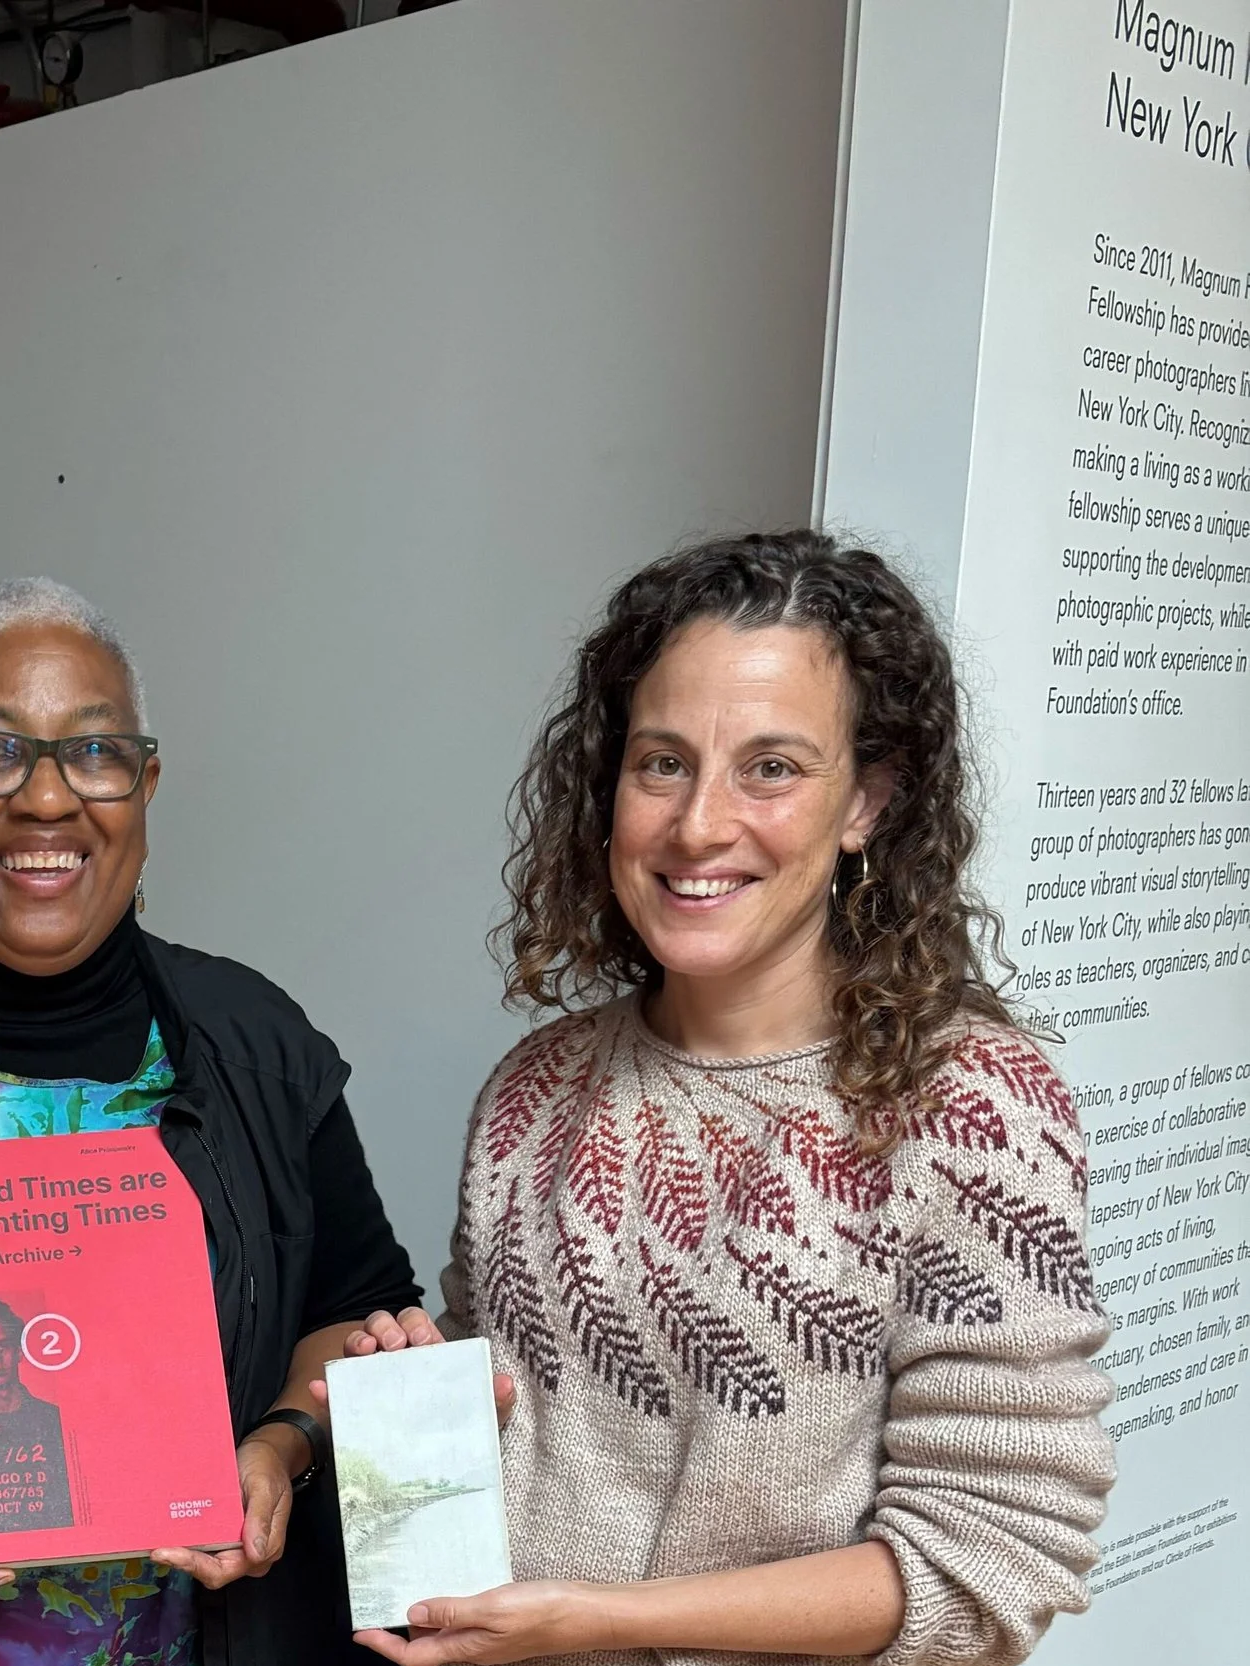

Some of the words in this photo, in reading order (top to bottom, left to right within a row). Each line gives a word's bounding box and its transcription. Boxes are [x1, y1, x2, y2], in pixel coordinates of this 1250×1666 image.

[1115, 0, 1234, 80] Magnum
[1106, 72, 1172, 144] New
[1183, 96, 1237, 166] York
[1094, 233, 1135, 271] Since
[1139, 246, 1175, 287] 2011,
[1180, 256, 1240, 298] Magnum
[1088, 286, 1166, 337] Fellowship
[1169, 304, 1195, 337] has
[1084, 347, 1132, 375] career
[1134, 350, 1236, 396] photographers
[1078, 388, 1113, 422] New
[1119, 395, 1149, 428] York
[1153, 403, 1184, 440] City.
[1073, 443, 1126, 481] making
[1130, 457, 1139, 476] a
[1143, 450, 1180, 488] living
[1184, 466, 1200, 485] as
[1204, 468, 1212, 487] a
[1069, 490, 1141, 532] fellowship
[1145, 509, 1191, 531] serves
[1194, 515, 1203, 533] a
[1207, 510, 1250, 543] unique
[1063, 546, 1141, 580] supporting
[1146, 549, 1168, 576] the
[1056, 590, 1154, 628] photographic
[1156, 599, 1215, 631] projects,
[1220, 602, 1250, 629] while
[1053, 639, 1082, 666] with
[1086, 641, 1120, 674] paid
[1124, 643, 1158, 669] work
[1161, 646, 1232, 677] experience
[1235, 648, 1247, 672] in
[1047, 687, 1138, 715] Foundation's
[1142, 689, 1183, 715] office.
[1037, 782, 1095, 808] Thirteen
[1098, 788, 1136, 813] years
[1140, 779, 1167, 805] and
[1170, 779, 1187, 804] 32
[1189, 778, 1234, 803] fellows
[1031, 836, 1074, 862] group
[1079, 826, 1095, 852] of
[1096, 823, 1196, 858] photographers
[1199, 821, 1222, 845] has
[1026, 874, 1086, 908] produce
[1091, 870, 1137, 896] vibrant
[1142, 865, 1179, 892] visual
[1181, 862, 1250, 894] storytelling
[1022, 921, 1038, 947] of
[1041, 919, 1075, 944] New
[1079, 914, 1108, 940] York
[1112, 912, 1142, 942] City,
[1148, 908, 1181, 934] while
[1184, 906, 1211, 930] also
[1016, 965, 1051, 992] roles
[1055, 969, 1072, 987] as
[1076, 956, 1137, 984] teachers,
[1143, 948, 1210, 980] organizers,
[1214, 942, 1240, 967] and
[1028, 1009, 1059, 1032] their
[1063, 995, 1150, 1030] communities.
[1119, 1085, 1128, 1101] a
[1131, 1078, 1169, 1104] group
[1173, 1068, 1188, 1091] of
[1190, 1064, 1232, 1088] fellows
[1095, 1120, 1148, 1145] exercise
[1152, 1110, 1167, 1134] of
[1169, 1101, 1246, 1132] collaborative
[1089, 1157, 1132, 1187] eaving
[1135, 1153, 1164, 1176] their
[1165, 1136, 1225, 1169] individual
[19, 1176, 113, 1204] Times
[119, 1169, 167, 1192] are
[1091, 1196, 1144, 1228] tapestry
[1146, 1187, 1161, 1211] of
[1163, 1184, 1192, 1207] New
[1196, 1174, 1222, 1199] York
[1225, 1170, 1250, 1194] City
[73, 1203, 167, 1228] Times
[1136, 1229, 1163, 1251] acts
[1166, 1219, 1181, 1243] of
[1182, 1215, 1216, 1240] living,
[1094, 1272, 1141, 1304] agency
[1143, 1262, 1158, 1286] of
[1159, 1247, 1234, 1281] communities
[1126, 1300, 1177, 1327] margins.
[1183, 1285, 1208, 1311] With
[1212, 1276, 1240, 1302] work
[39, 1329, 62, 1356] 2
[1149, 1331, 1192, 1356] chosen
[1196, 1314, 1231, 1342] family,
[1116, 1368, 1182, 1403] tenderness
[1185, 1354, 1208, 1380] and
[1210, 1352, 1236, 1372] care
[1238, 1343, 1249, 1363] in
[1179, 1389, 1203, 1415] and
[1204, 1384, 1239, 1407] honor
[28, 1501, 44, 1512] 69
[168, 1499, 213, 1511] GNOMIC
[169, 1508, 203, 1519] BOOK
